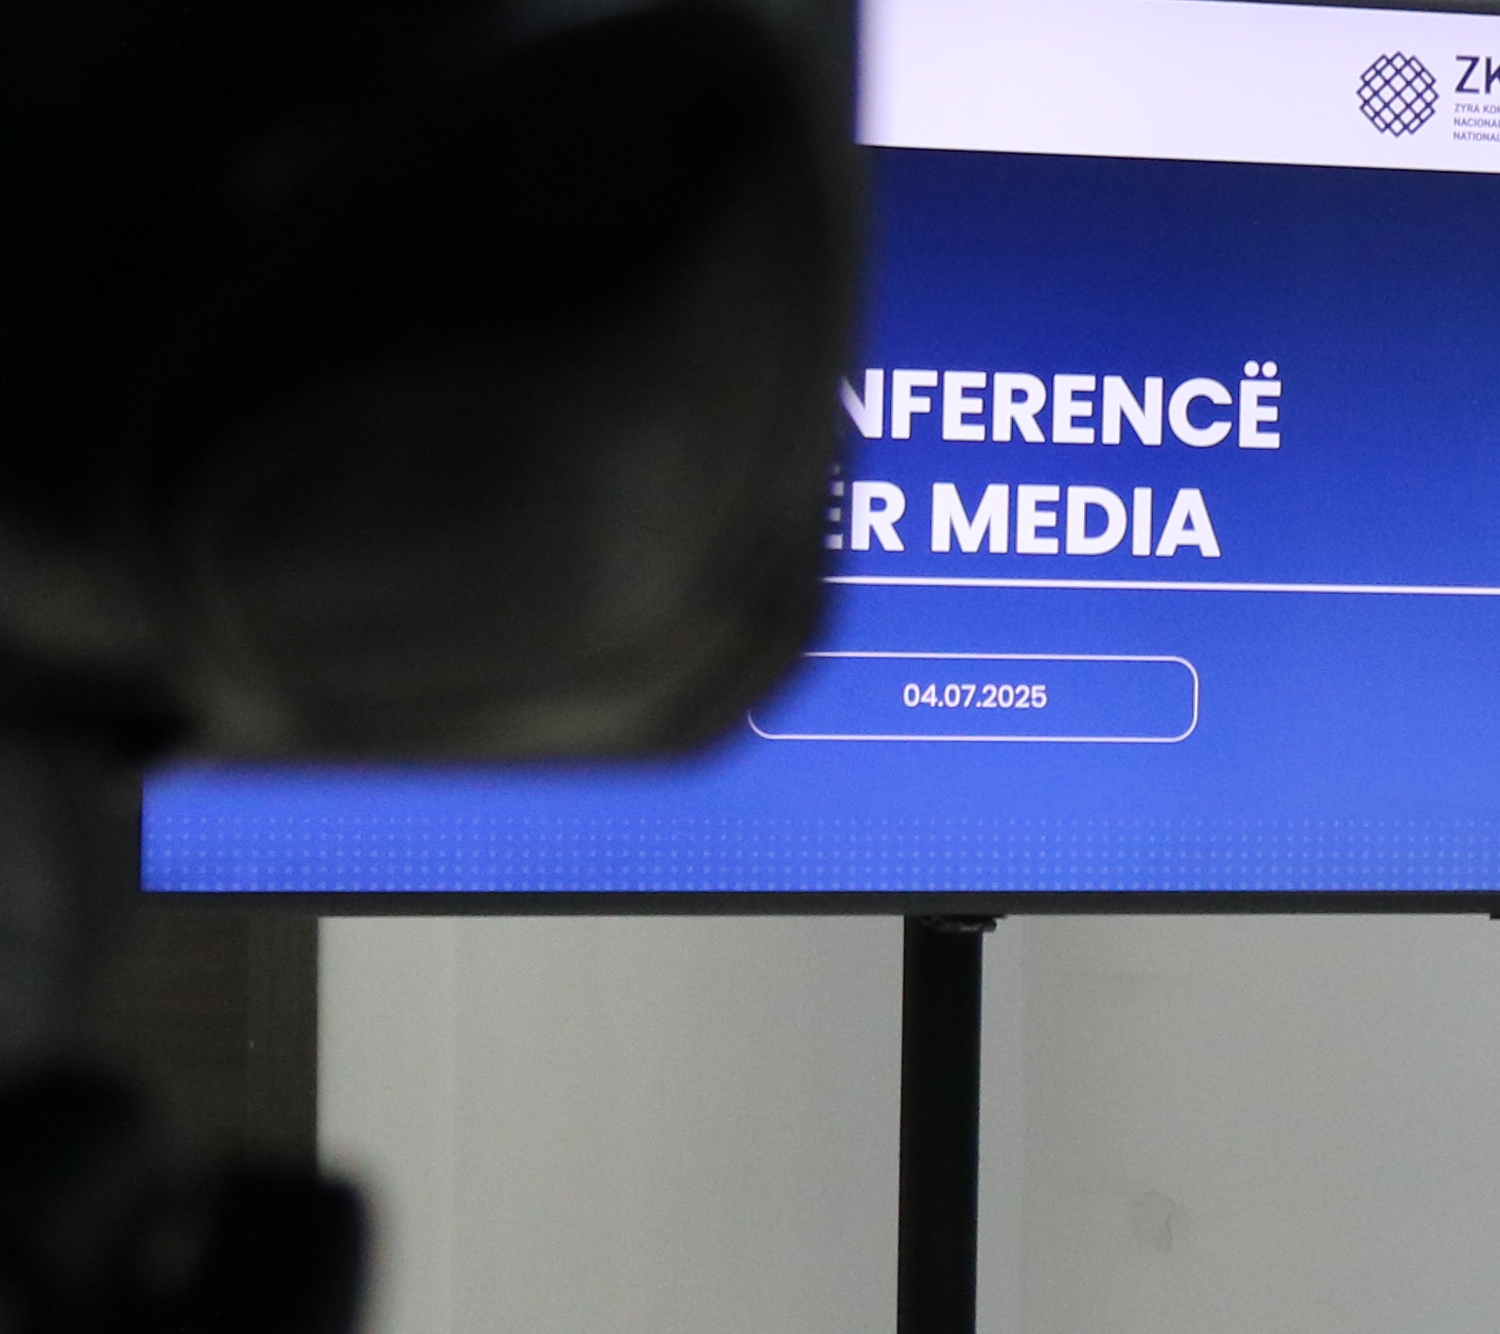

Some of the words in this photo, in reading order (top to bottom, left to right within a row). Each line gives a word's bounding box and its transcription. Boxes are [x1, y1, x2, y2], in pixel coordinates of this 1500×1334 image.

[1453, 102, 1480, 114] ZYRA
[837, 359, 1283, 450] NFERENCË
[930, 480, 1222, 558] MEDIA
[902, 682, 1048, 710] 04.07.2025
